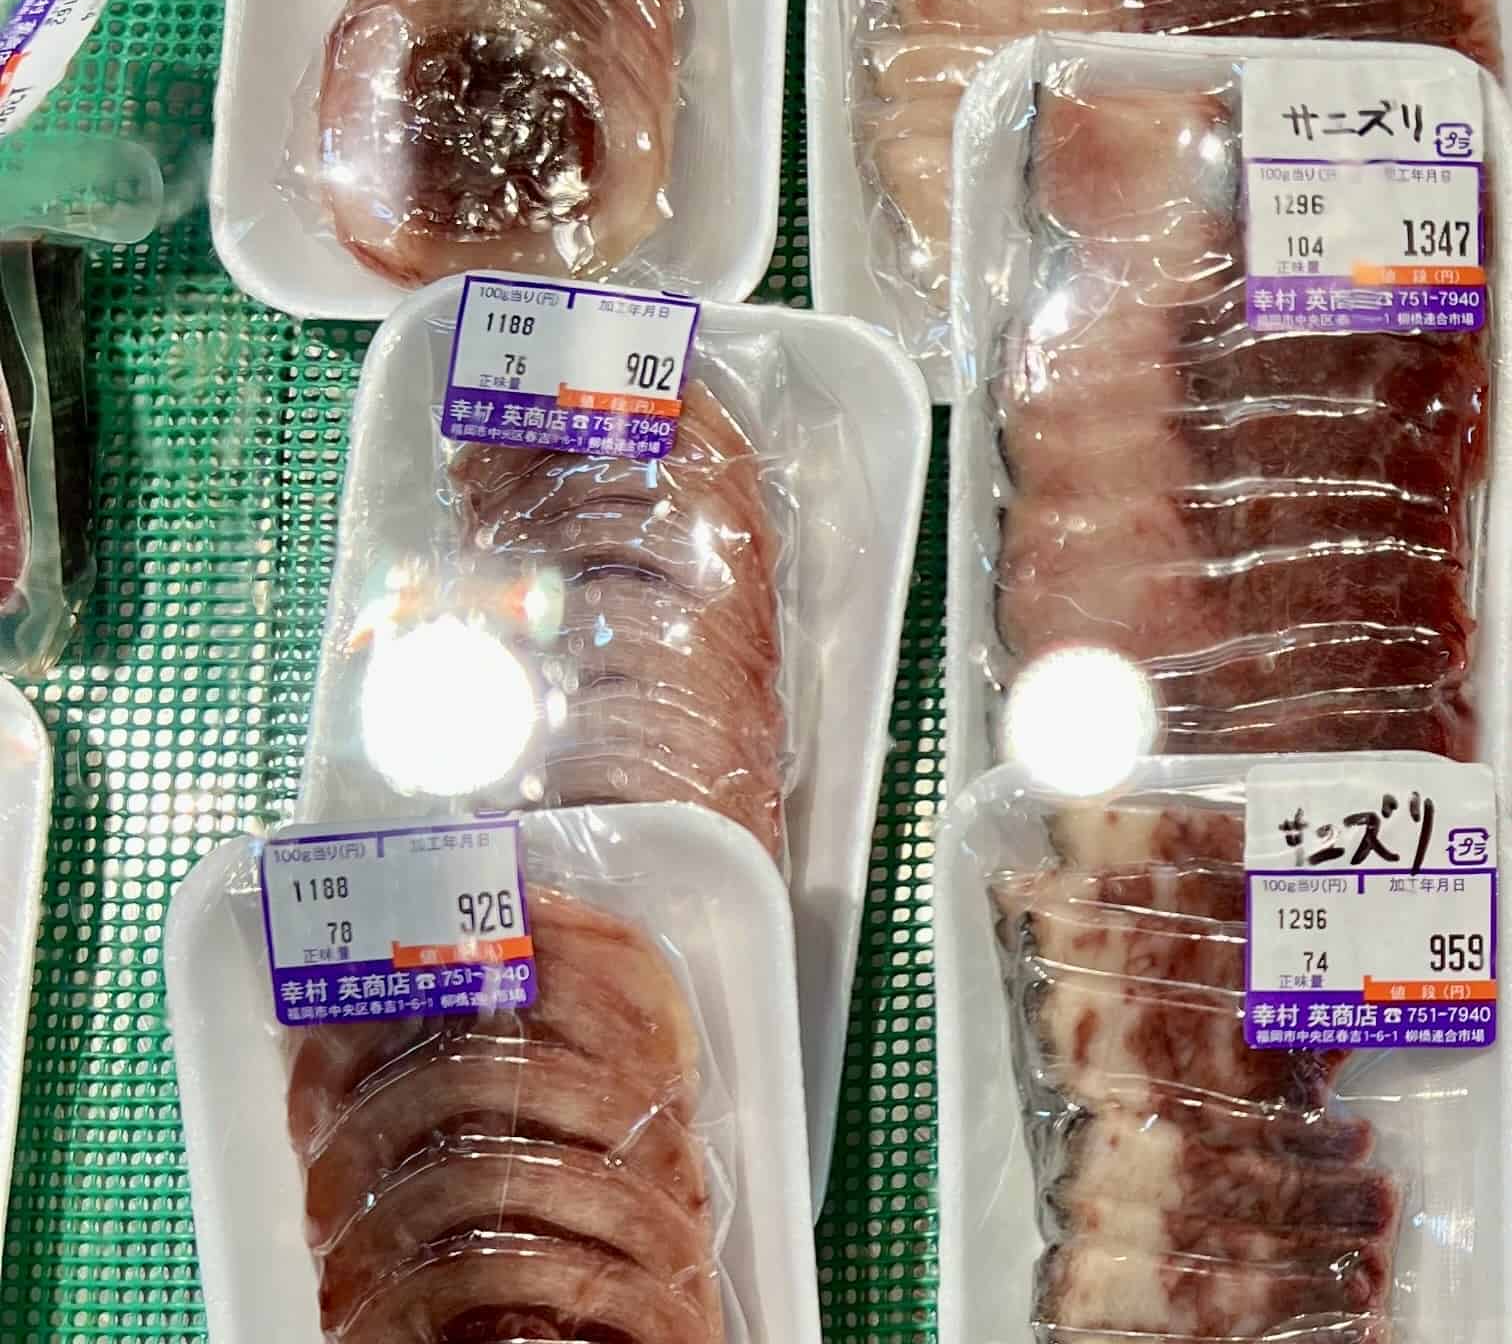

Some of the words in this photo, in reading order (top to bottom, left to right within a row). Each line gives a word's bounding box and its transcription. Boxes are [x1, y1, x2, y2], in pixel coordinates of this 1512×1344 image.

[1444, 132, 1471, 149] プラ
[1273, 195, 1324, 214] 1296
[1288, 236, 1324, 257] 104
[1402, 219, 1470, 257] 1347
[1253, 289, 1296, 310] 幸村
[1400, 291, 1479, 306] 751-7940
[486, 312, 535, 336] 1188
[626, 352, 675, 391] 902
[450, 399, 495, 423] 幸村
[502, 404, 569, 429] 英商店
[1458, 839, 1487, 856] プラ
[293, 876, 349, 903] 1188
[458, 890, 514, 935] 926
[1277, 909, 1328, 930] 1296
[1303, 951, 1328, 973] 74
[1430, 933, 1484, 972] 959
[280, 978, 328, 1004] 幸村
[338, 972, 411, 1000] 英商店
[1279, 974, 1326, 989] 正味量
[1253, 1004, 1299, 1027] 幸村
[1308, 1003, 1378, 1027] 英商店
[1407, 1006, 1491, 1023] 751-7940
